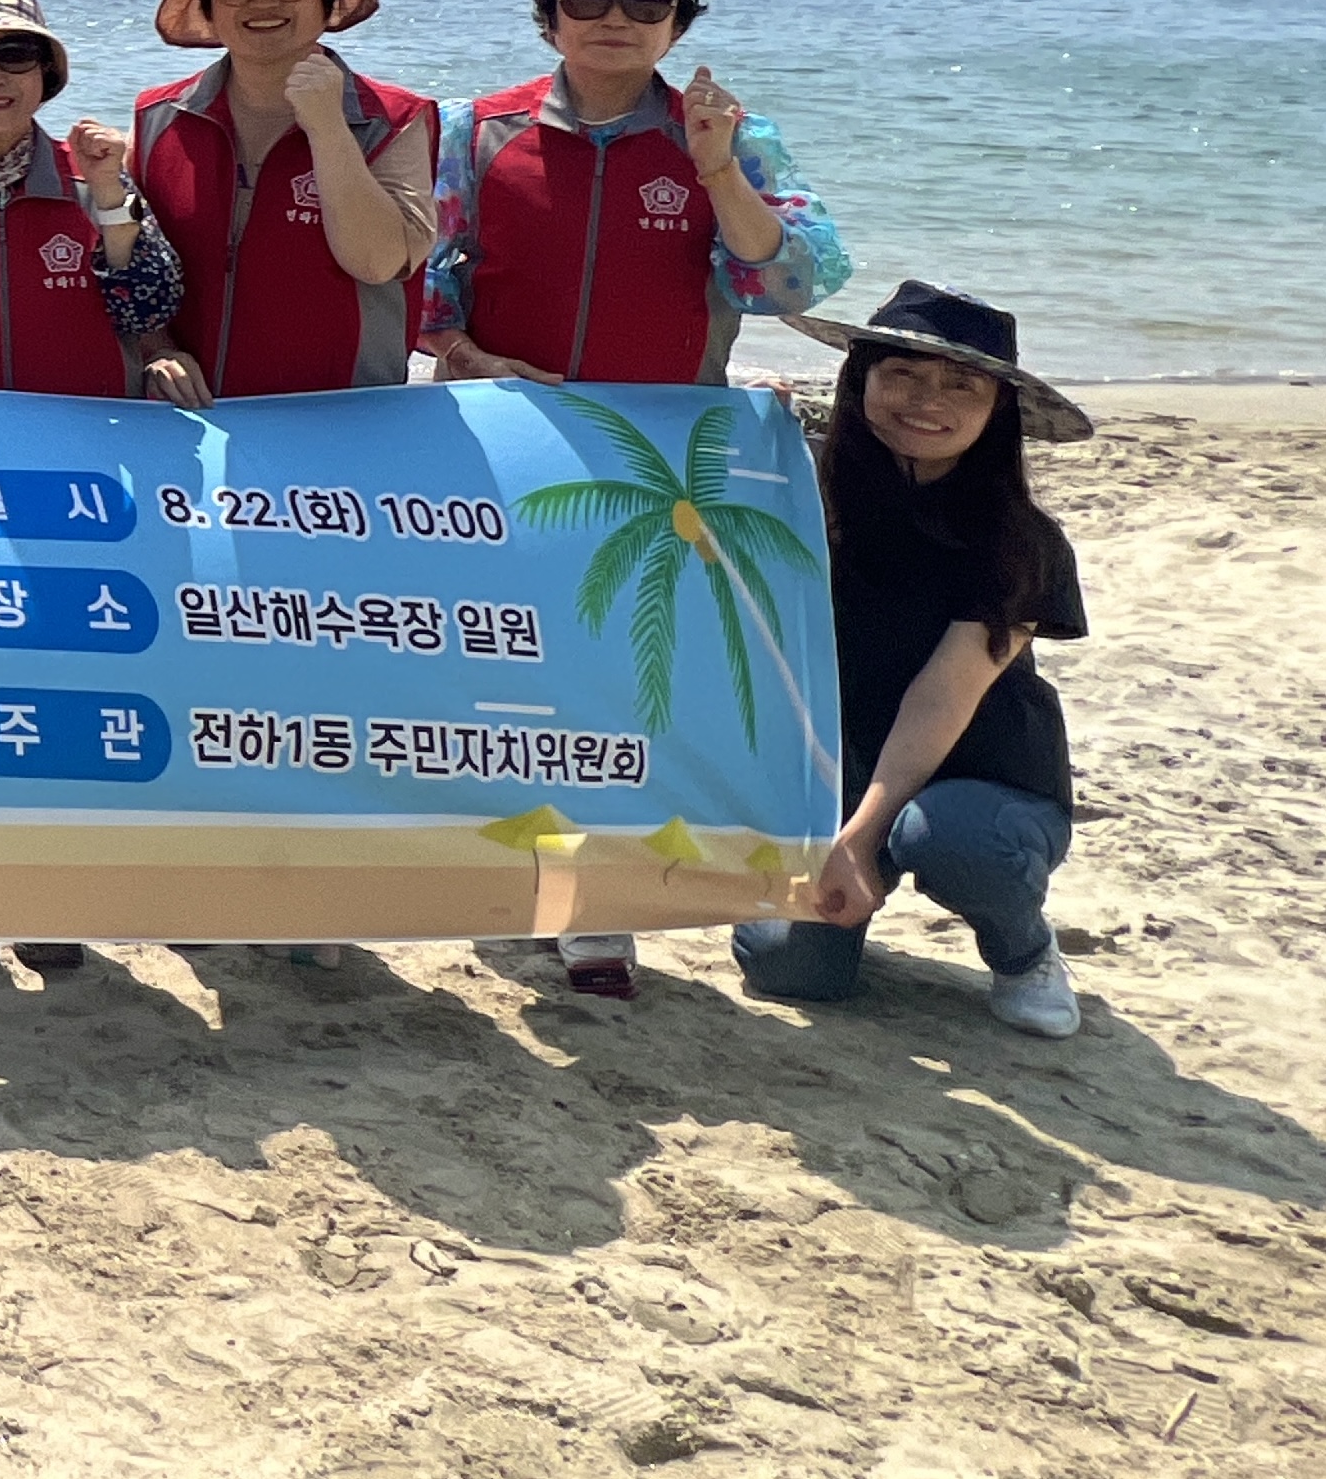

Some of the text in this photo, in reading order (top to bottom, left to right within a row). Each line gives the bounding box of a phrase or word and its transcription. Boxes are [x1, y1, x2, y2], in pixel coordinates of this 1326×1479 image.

[160, 486, 207, 525] 8.
[218, 488, 367, 536] 22.(화)
[380, 494, 505, 543] 10:00
[178, 586, 446, 650] 일산해수욕장
[456, 604, 542, 659] 일원
[191, 708, 355, 770] 전하1동
[368, 722, 649, 787] 주민자치위원회
